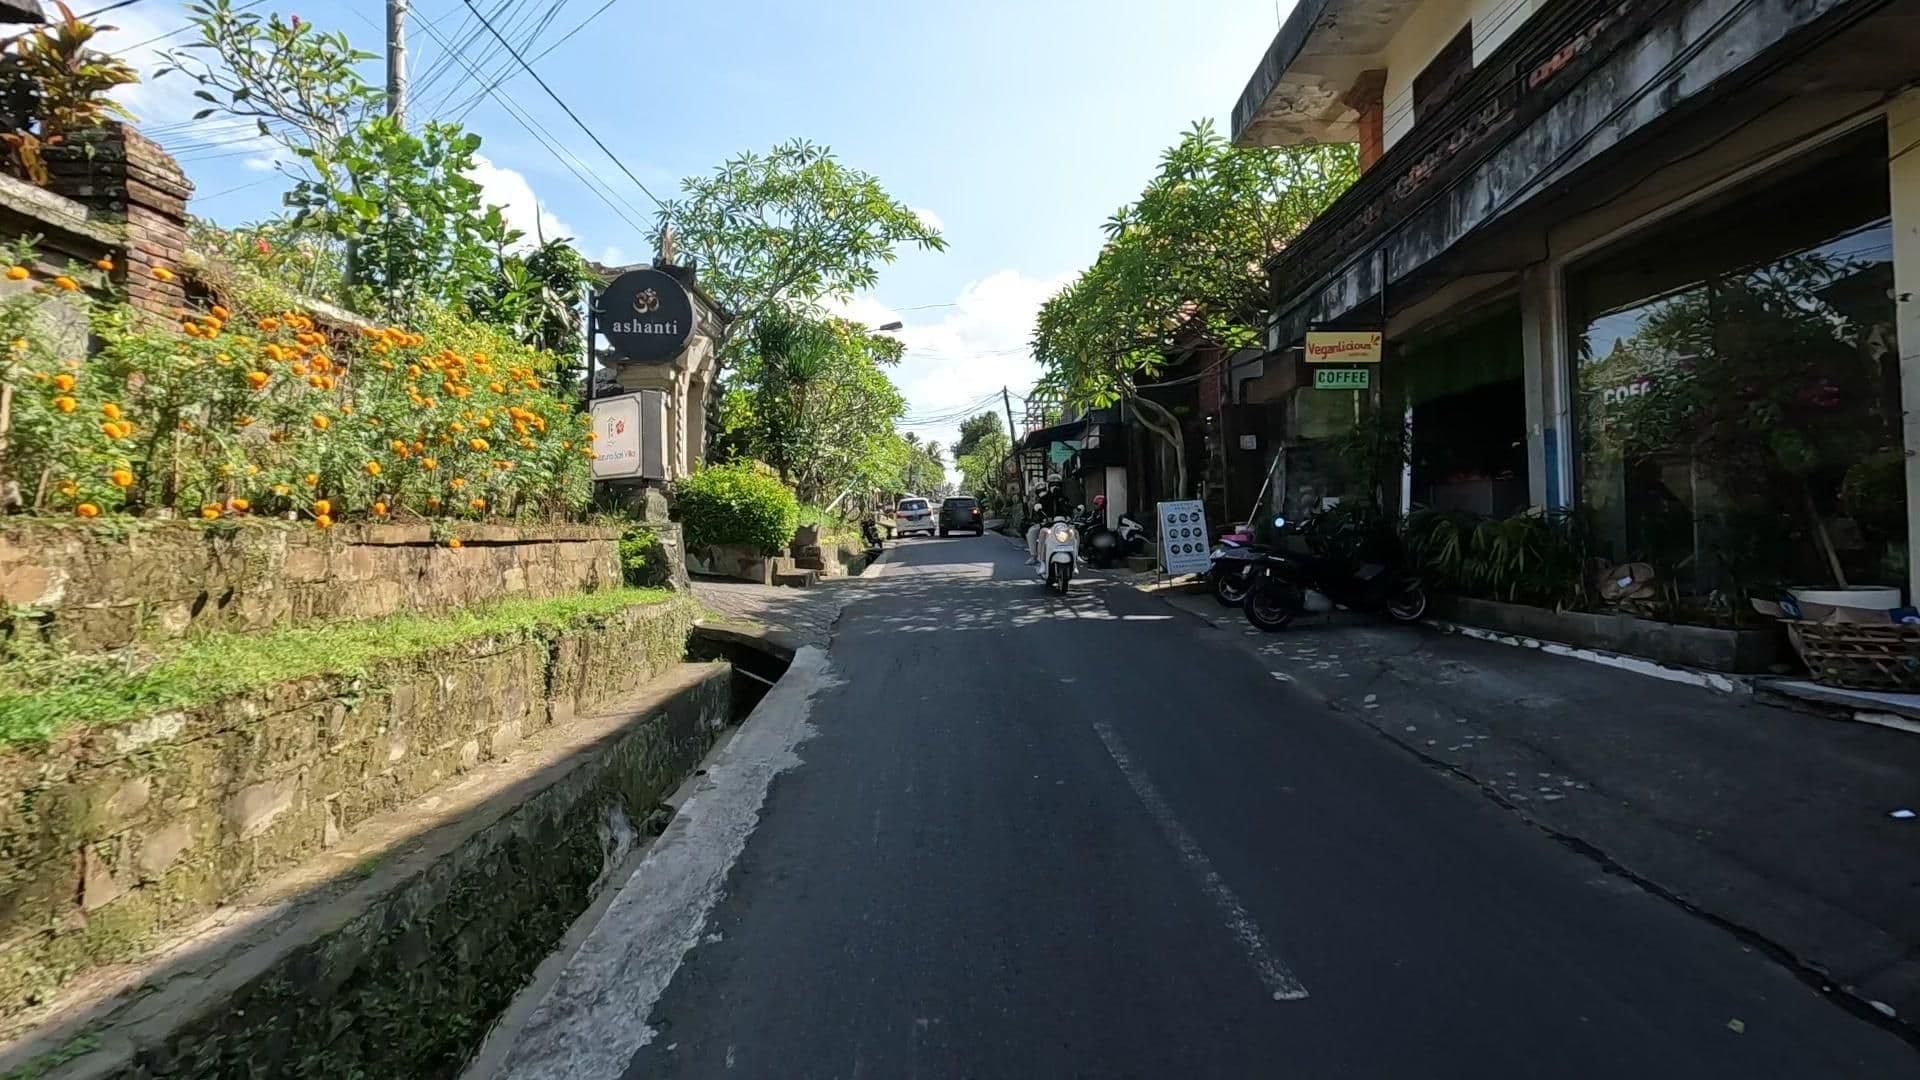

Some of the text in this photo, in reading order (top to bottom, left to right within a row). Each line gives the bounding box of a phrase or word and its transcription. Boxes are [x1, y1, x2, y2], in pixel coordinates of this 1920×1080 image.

[612, 318, 678, 335] ashanti
[1308, 340, 1372, 360] Veganlicious
[1318, 371, 1367, 384] COFFEE
